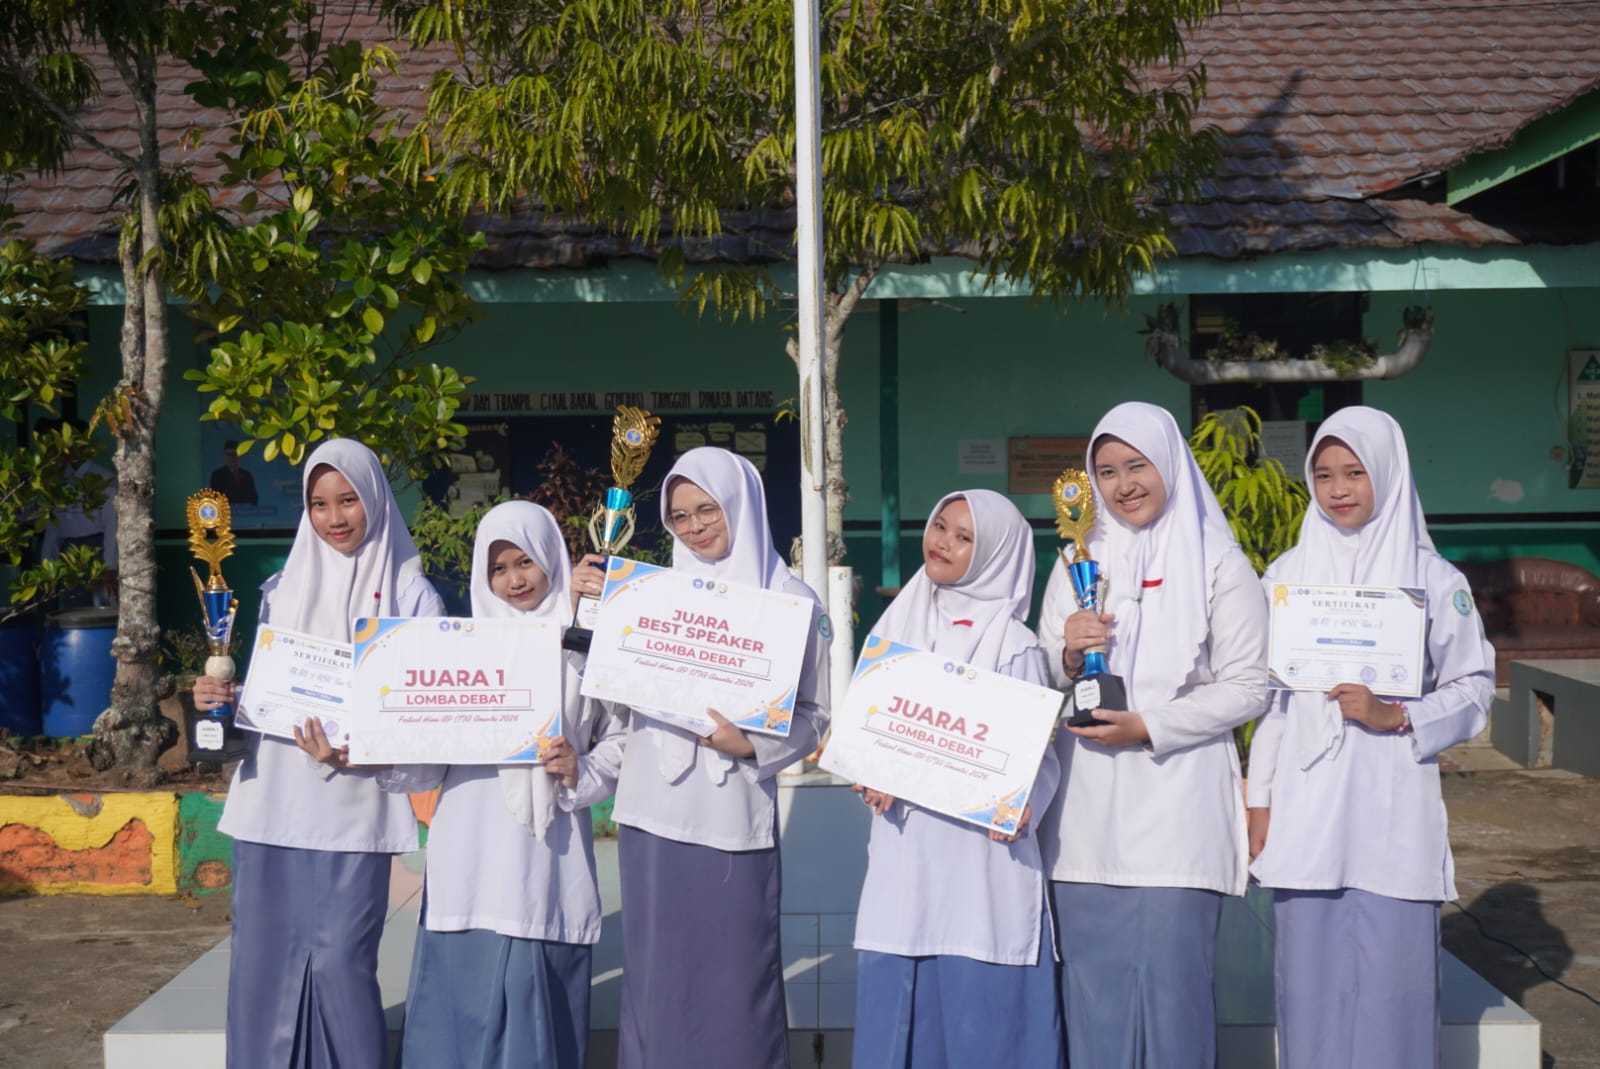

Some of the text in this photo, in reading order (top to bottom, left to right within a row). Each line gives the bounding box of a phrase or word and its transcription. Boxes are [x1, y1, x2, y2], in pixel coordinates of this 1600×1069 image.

[1311, 599, 1377, 609] SERTIFIKAT
[672, 609, 729, 632] JUARA
[637, 616, 765, 654] BEST SPEAKER
[294, 650, 352, 669] SERTIFIKAT
[645, 639, 747, 669] LOMBA DEBAT
[404, 668, 505, 687] JUARA 1
[406, 694, 506, 705] LOMBA DEBAT
[887, 695, 990, 742] JUARA 2
[887, 721, 984, 761] LOMBA DEBAT
